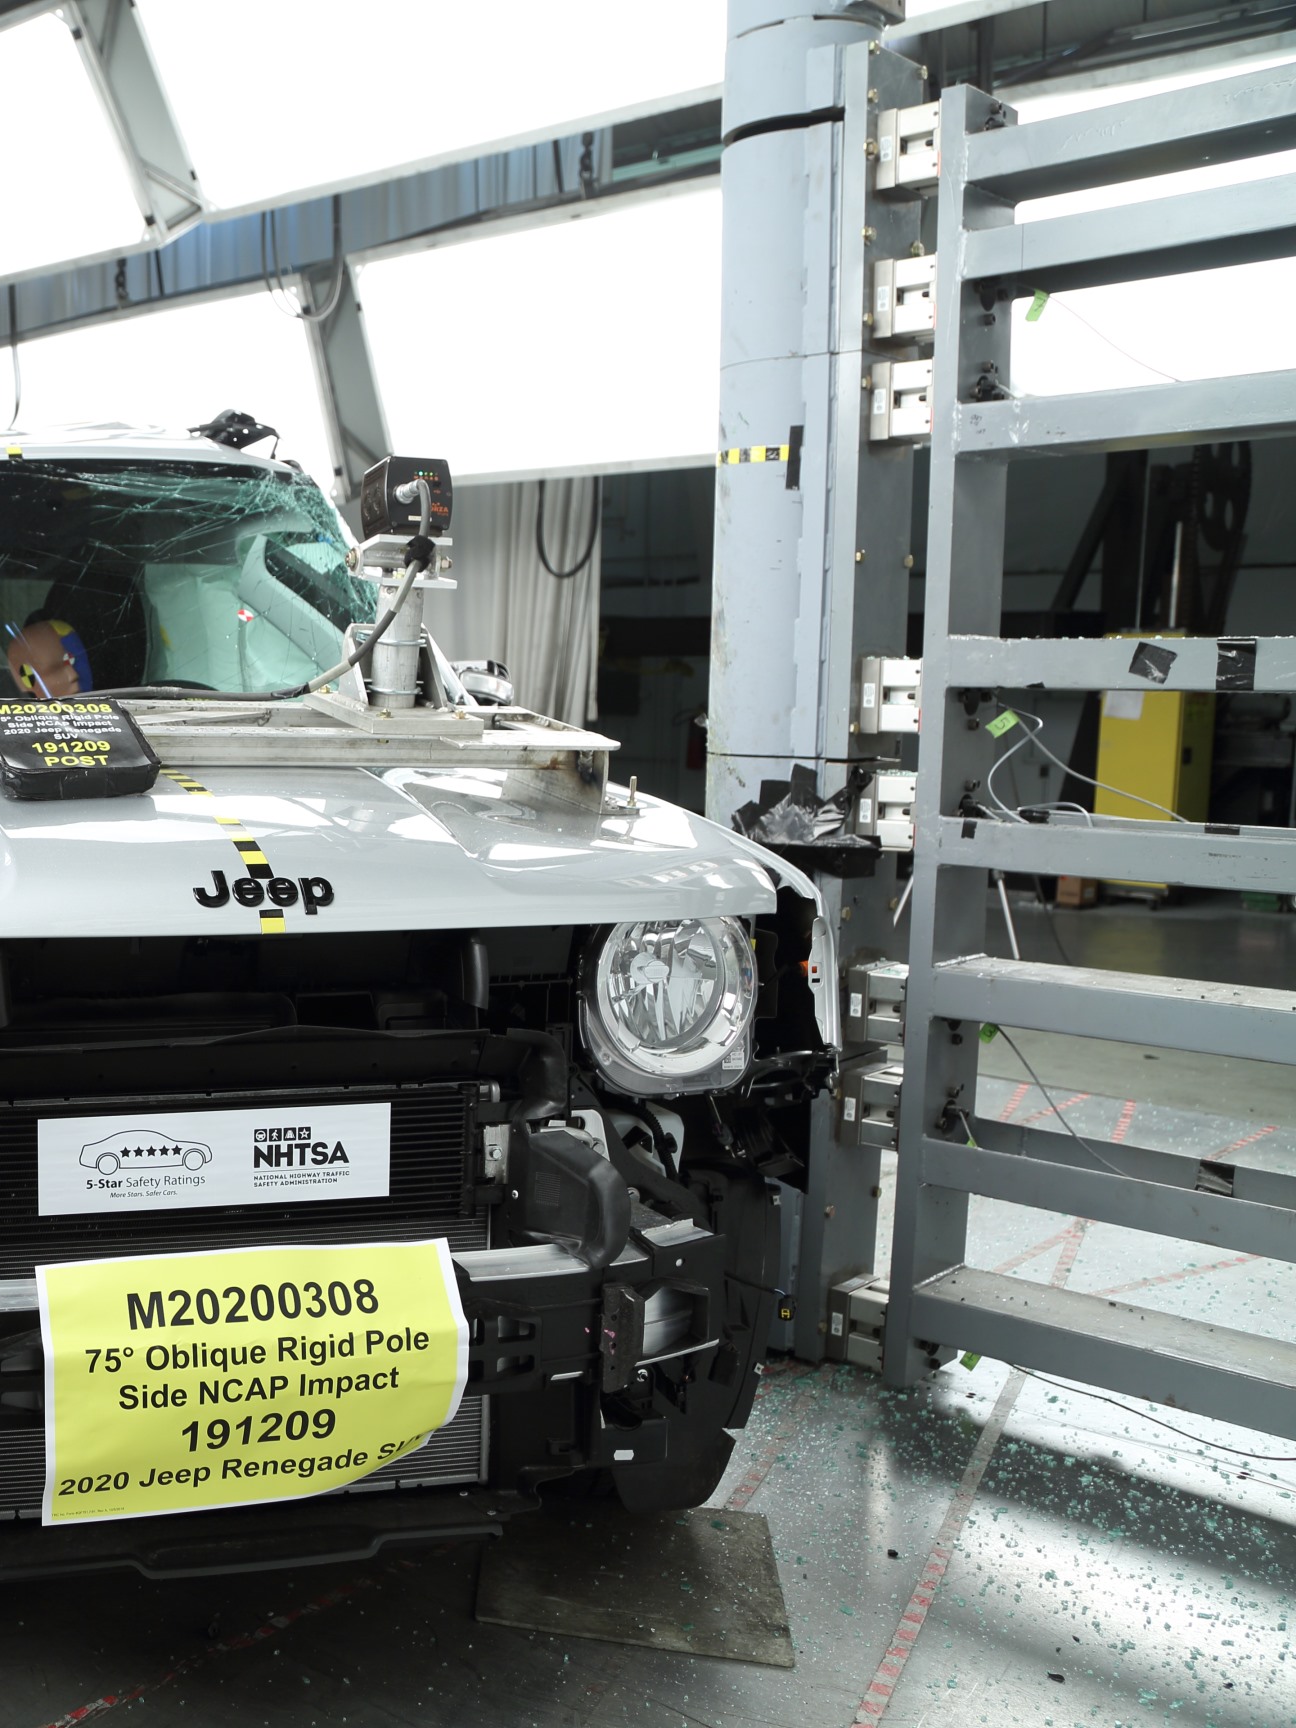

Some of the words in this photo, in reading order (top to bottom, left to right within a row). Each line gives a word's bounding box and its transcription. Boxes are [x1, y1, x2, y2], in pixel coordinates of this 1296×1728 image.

[31, 740, 111, 754] 191209
[65, 726, 122, 734] Renegade
[44, 755, 109, 767] POST
[192, 870, 335, 915] Jeep
[253, 1140, 350, 1169] NHTSA
[85, 1178, 124, 1190] 5-Star
[125, 1176, 161, 1189] Safety
[163, 1174, 206, 1187] Ratings
[253, 1180, 279, 1188] SAFETY
[279, 1177, 338, 1186] ADMINISTRATION
[126, 1278, 379, 1330] M20200308
[85, 1346, 134, 1373] 75°
[145, 1342, 266, 1373] Oblique
[277, 1331, 354, 1366] Rigid
[365, 1326, 430, 1355] Pole
[118, 1383, 188, 1410] Side
[199, 1375, 289, 1405] NCAP
[299, 1366, 400, 1399] Impact
[181, 1408, 336, 1453] 191209
[57, 1471, 130, 1497] 2020
[138, 1466, 211, 1488] Jeep
[221, 1448, 369, 1480] Renegade
